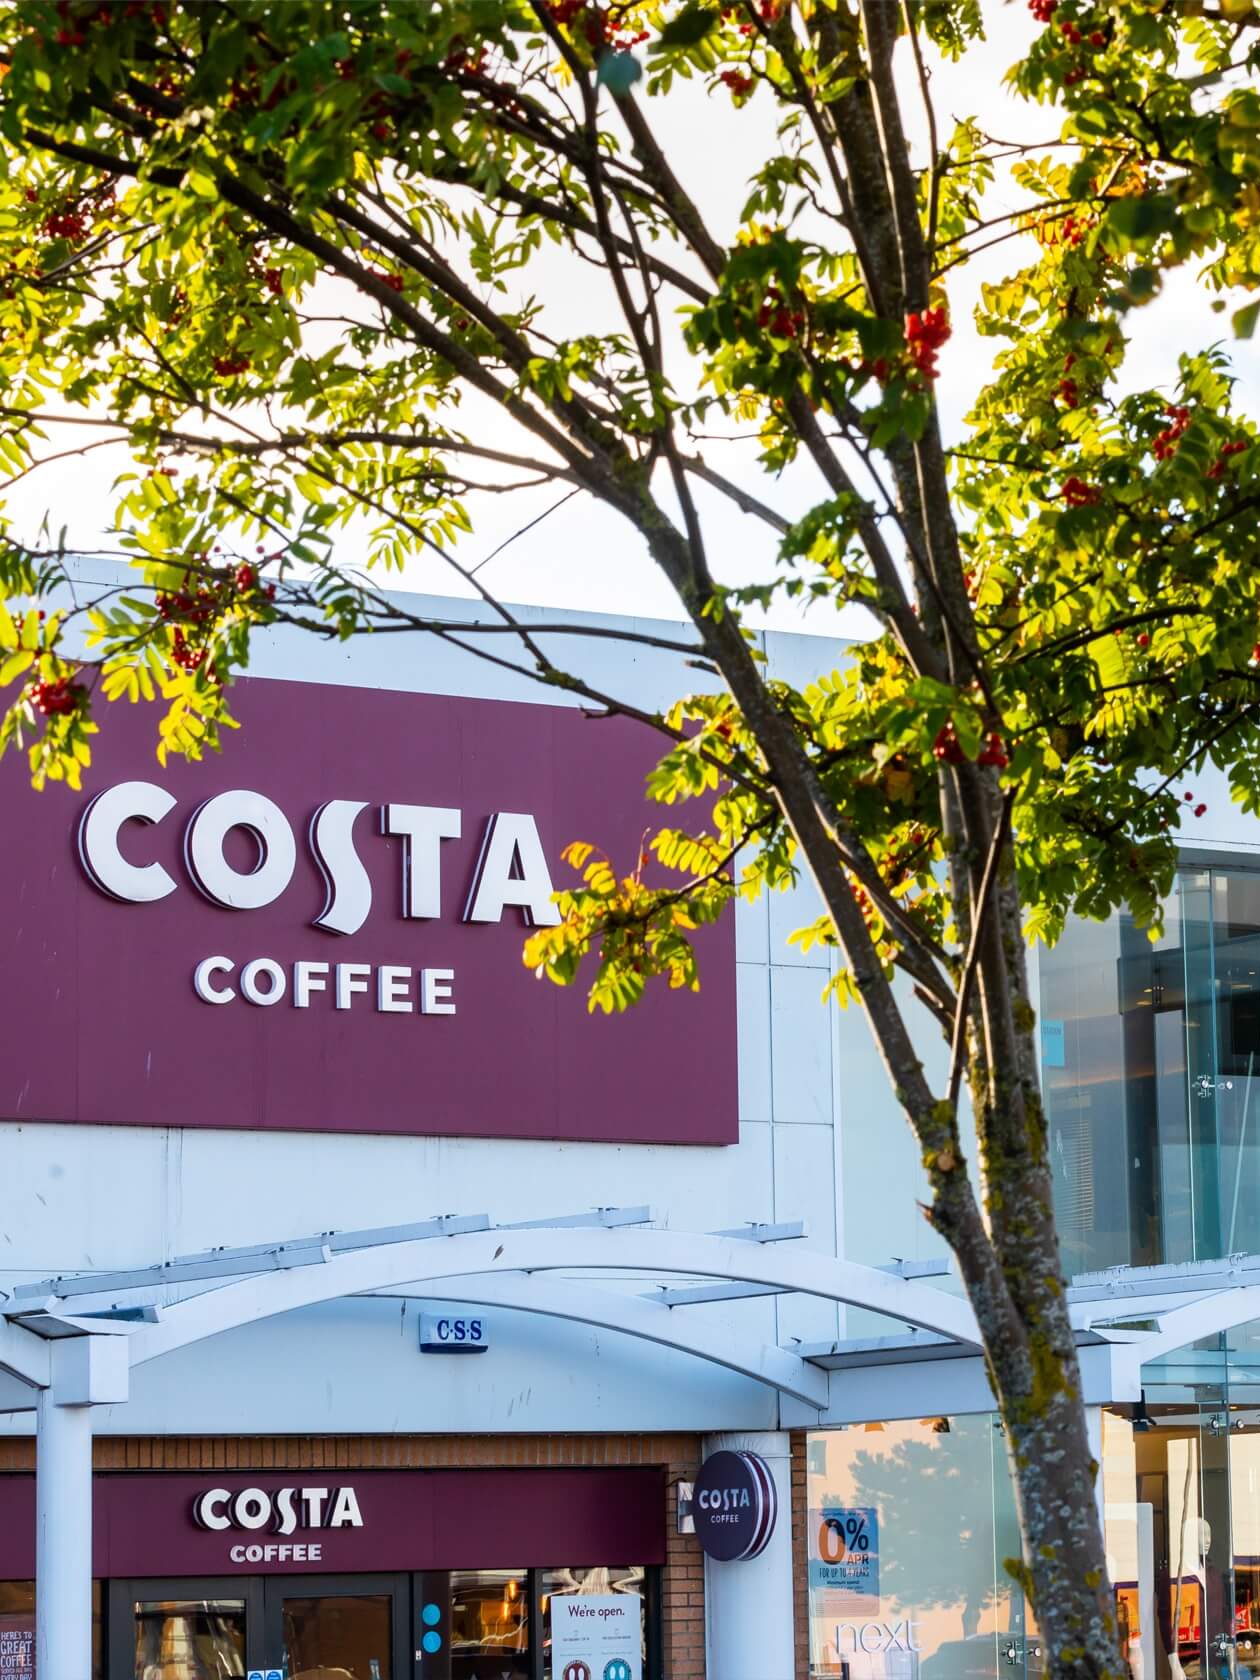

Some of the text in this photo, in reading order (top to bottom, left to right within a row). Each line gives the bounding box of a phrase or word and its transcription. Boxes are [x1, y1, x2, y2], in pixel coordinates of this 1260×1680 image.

[77, 780, 562, 936] COSTA
[194, 956, 457, 1015] COFFEE
[698, 1487, 750, 1511] COSTA
[194, 1487, 364, 1536] COSTA
[711, 1514, 740, 1524] COFFEE
[818, 1518, 869, 1566] 0%
[230, 1543, 323, 1563] COFFEE
[846, 1553, 870, 1565] APR
[819, 1567, 830, 1579] FOR
[831, 1567, 839, 1578] UP
[840, 1567, 847, 1578] TO
[568, 1604, 625, 1622] We're open.
[23, 1631, 33, 1640] TO
[836, 1619, 925, 1655] next
[0, 1640, 33, 1655] GREAT
[0, 1654, 33, 1668] COFFEE
